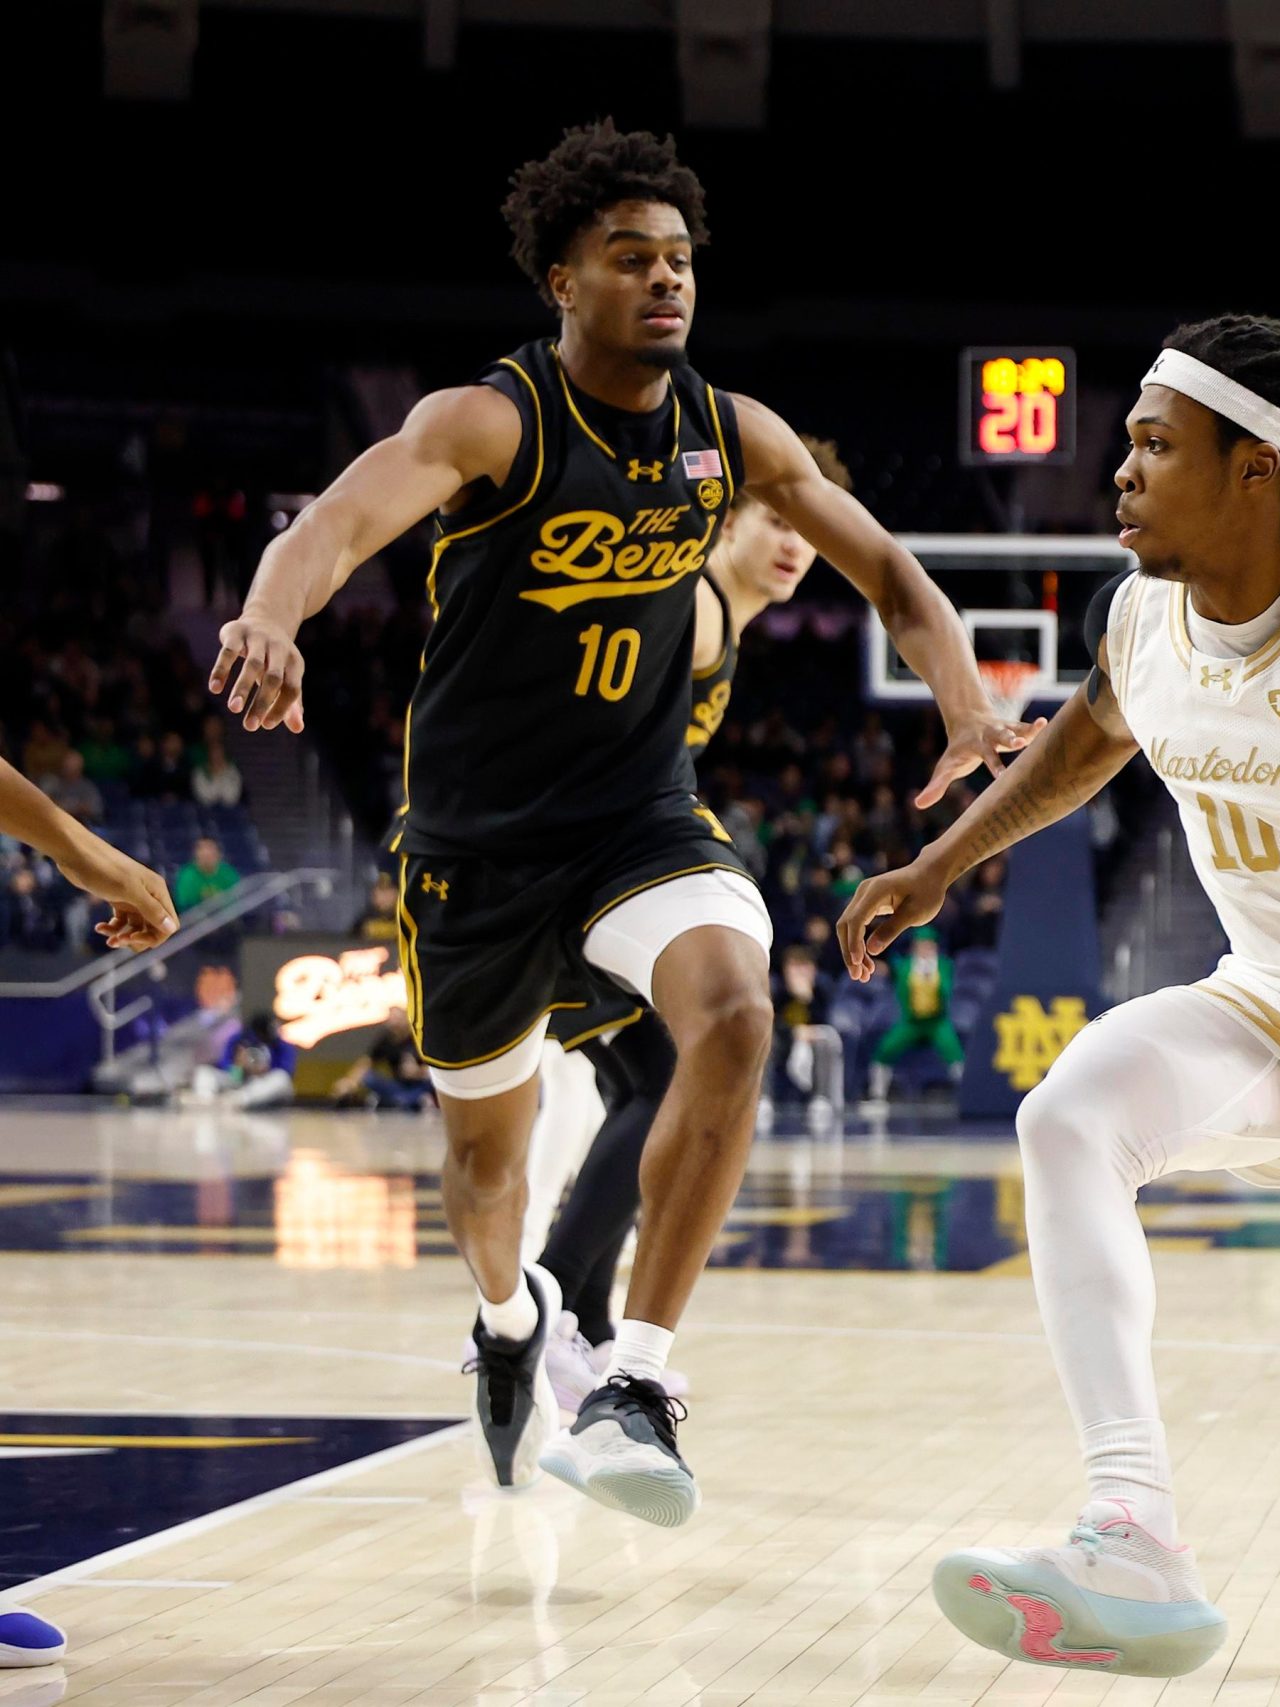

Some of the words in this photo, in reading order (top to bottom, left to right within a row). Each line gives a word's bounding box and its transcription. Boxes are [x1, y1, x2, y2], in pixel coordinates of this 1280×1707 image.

[979, 392, 1057, 454] 20
[530, 510, 717, 581] Bend
[628, 505, 692, 535] THE
[575, 623, 641, 701] 10
